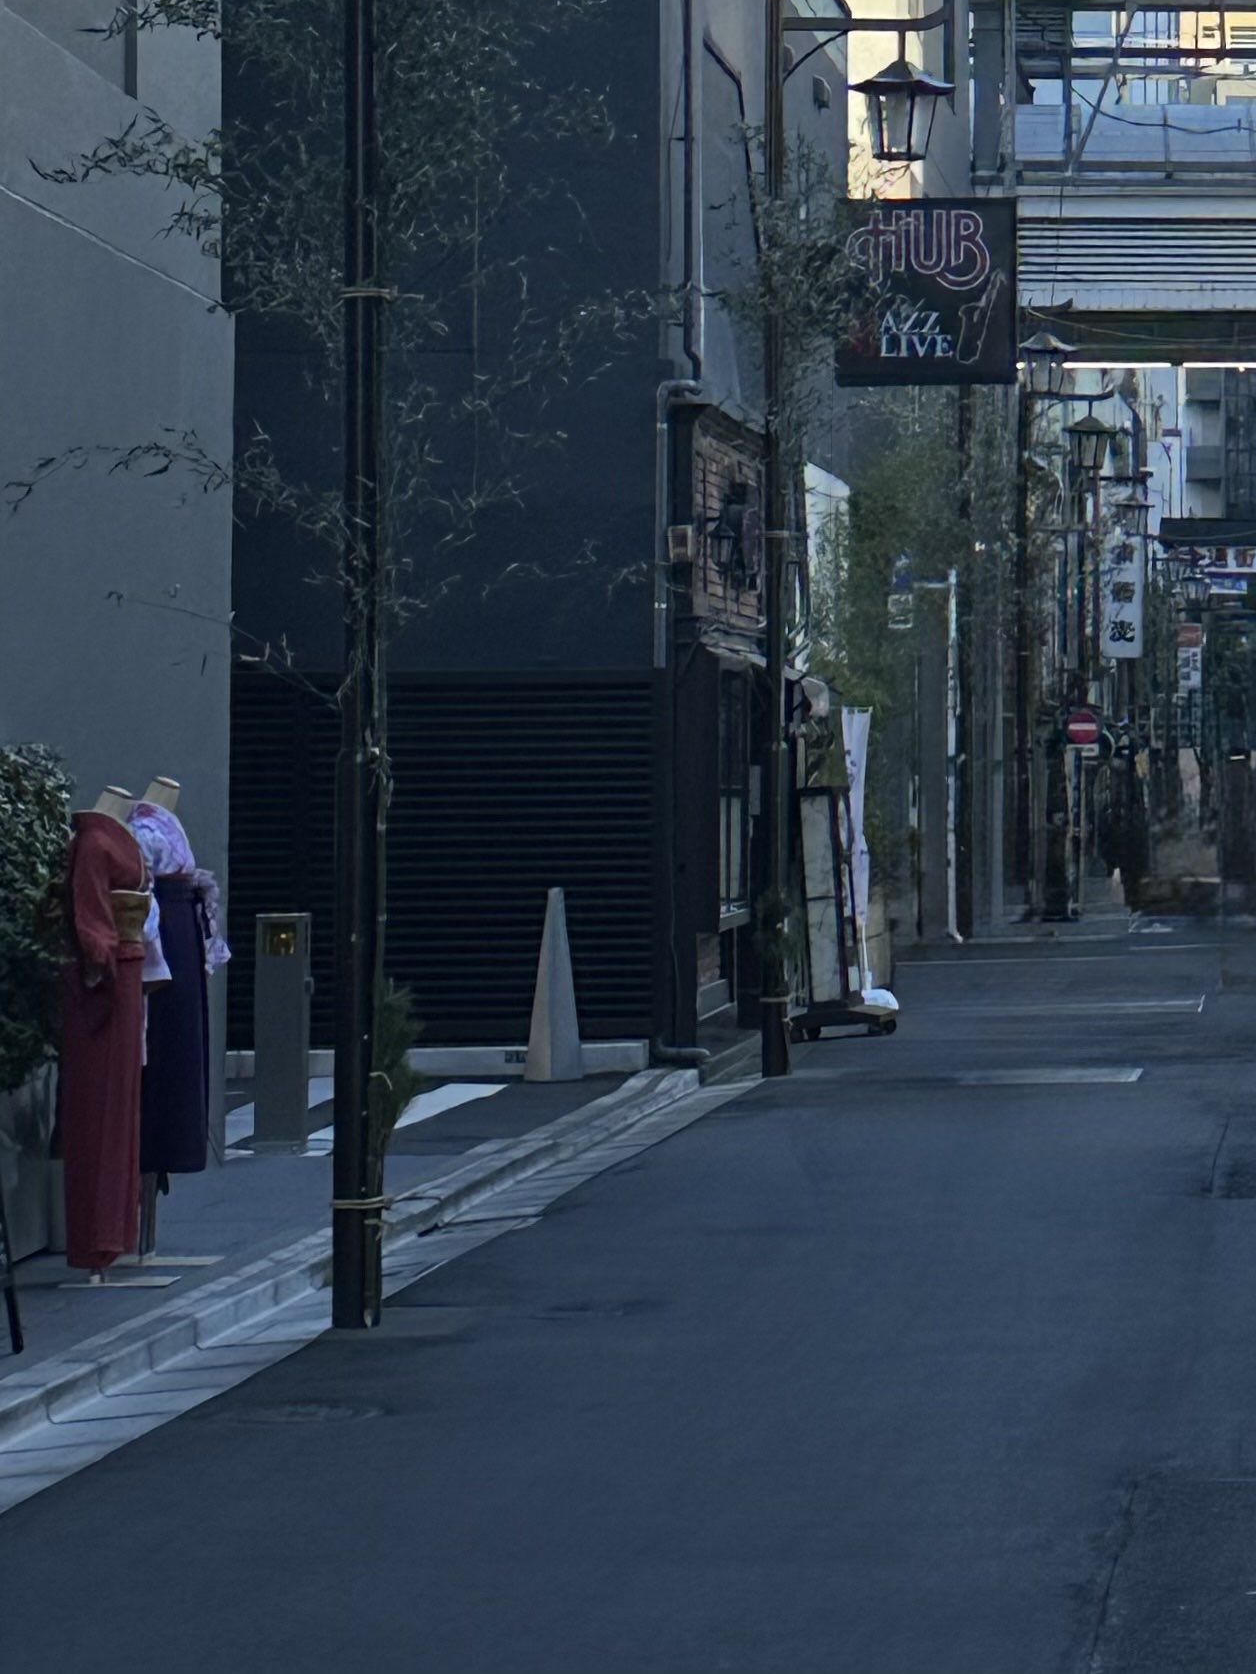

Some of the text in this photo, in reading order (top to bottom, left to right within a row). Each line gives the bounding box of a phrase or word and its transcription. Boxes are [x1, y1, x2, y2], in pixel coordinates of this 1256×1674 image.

[845, 209, 991, 291] HUB
[876, 310, 941, 334] AZZ
[880, 334, 954, 358] LIVE
